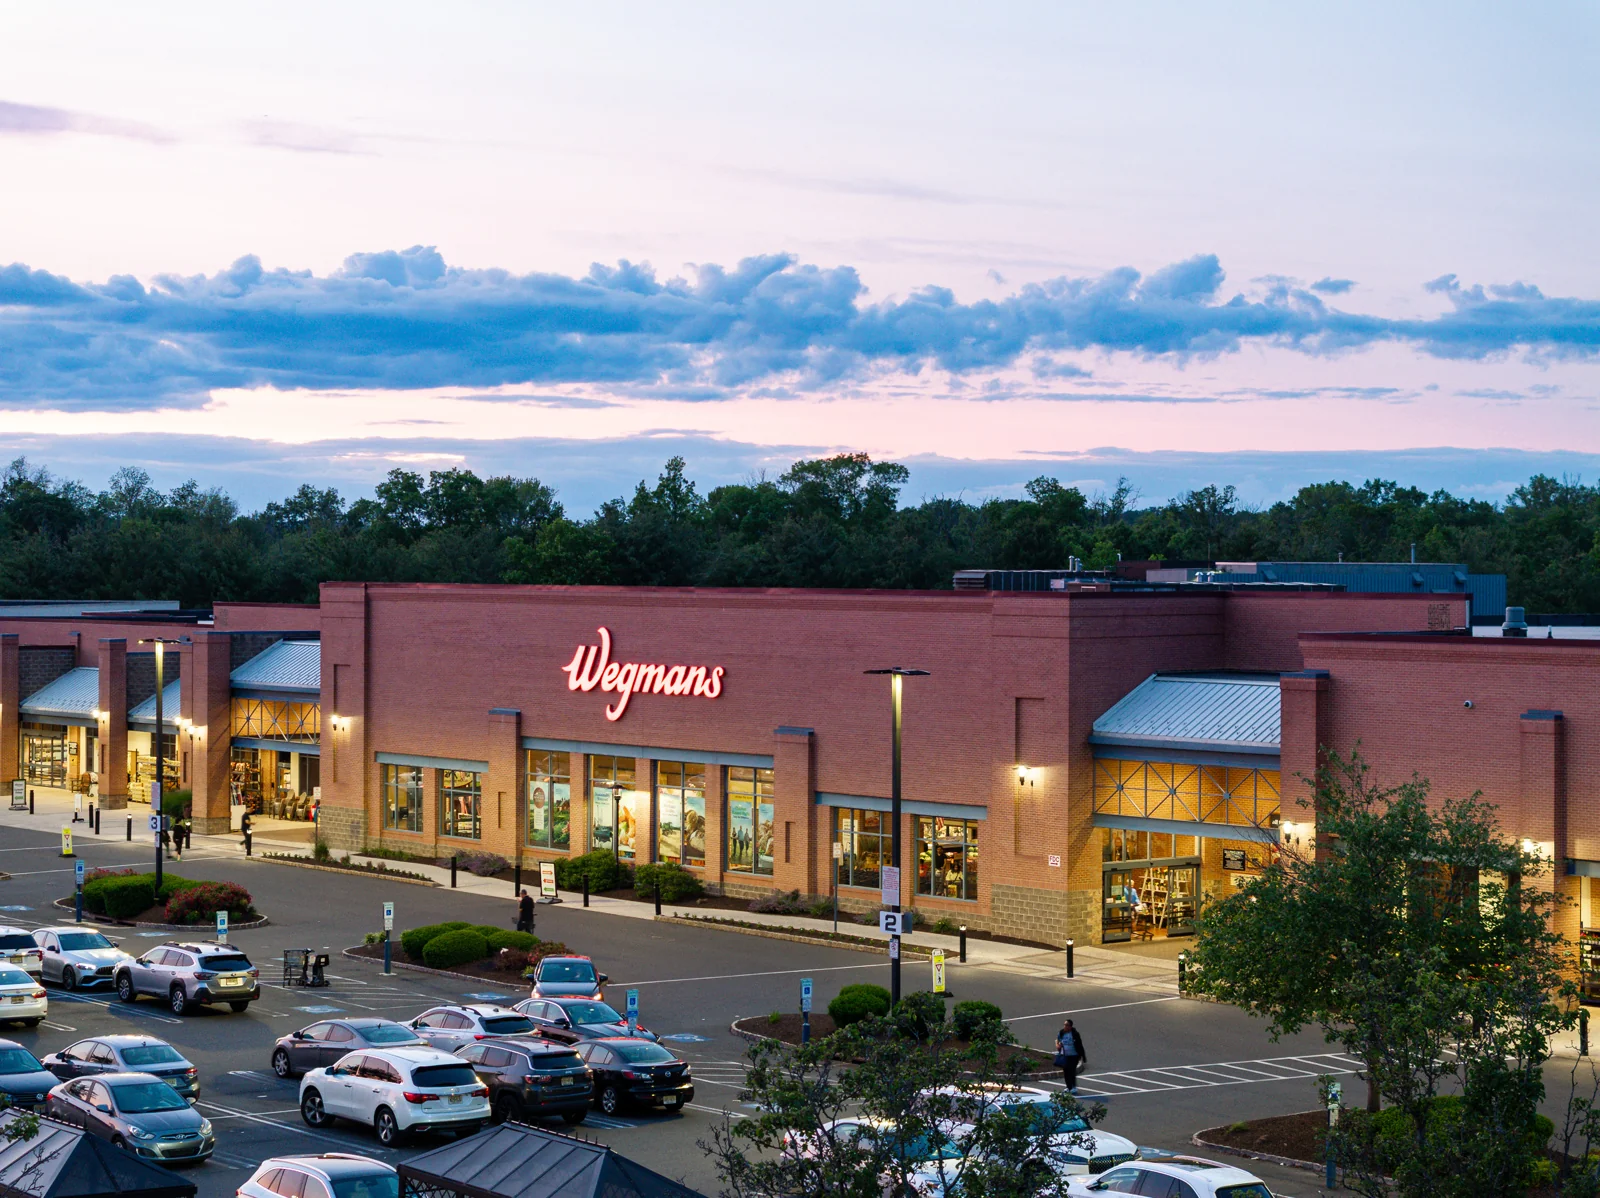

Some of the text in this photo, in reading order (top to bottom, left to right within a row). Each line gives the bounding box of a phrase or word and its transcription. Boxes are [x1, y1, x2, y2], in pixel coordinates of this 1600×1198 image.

[562, 627, 724, 721] Wegmans
[151, 817, 158, 829] 3
[885, 914, 897, 932] 2
